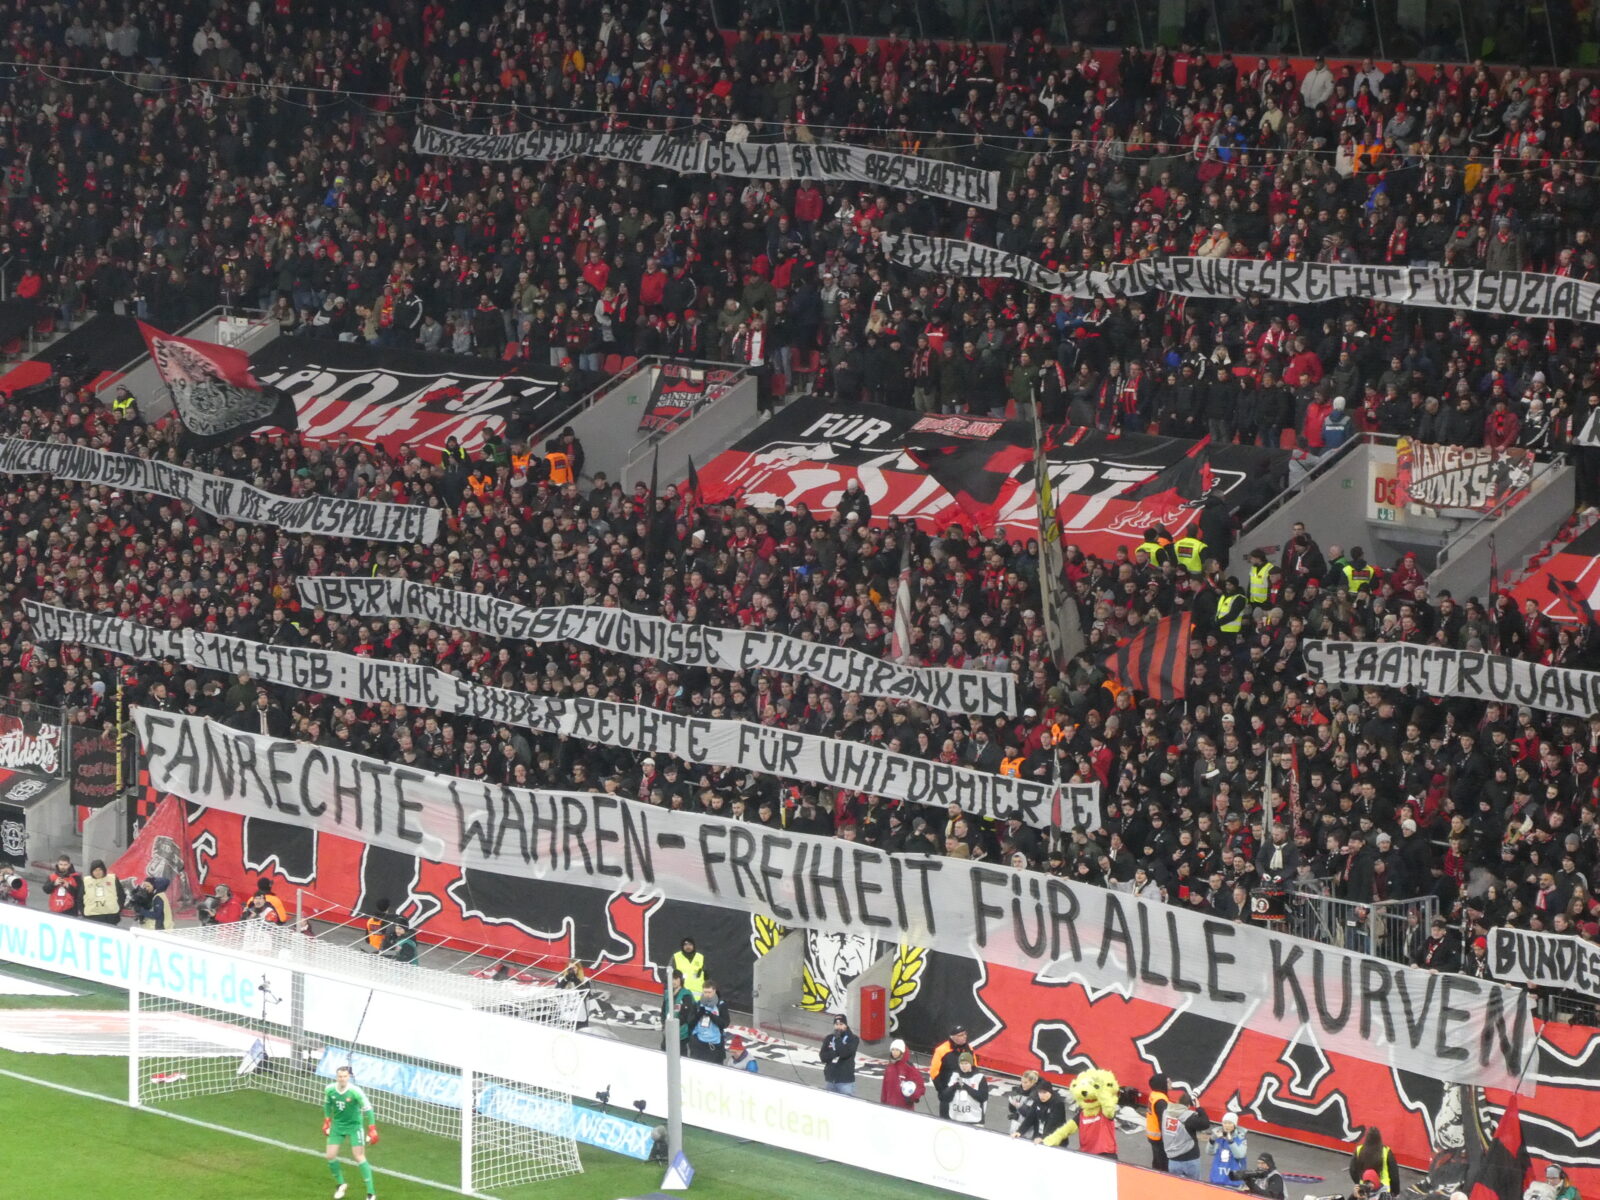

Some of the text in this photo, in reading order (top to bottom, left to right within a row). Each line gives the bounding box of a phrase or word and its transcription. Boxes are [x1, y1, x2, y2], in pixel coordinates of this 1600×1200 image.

[703, 140, 780, 177] GEWA
[791, 144, 852, 177] SPORT
[864, 154, 991, 205] ABSCHAFFEN
[1408, 267, 1474, 306] FÜR
[800, 412, 892, 444] FÜR
[202, 479, 231, 513] FÜR
[237, 486, 265, 519] DIE
[268, 497, 428, 541] BUNDESPOLIZEI
[25, 602, 124, 645] REFORM
[131, 624, 184, 661] DES
[359, 661, 440, 706] KEINE
[738, 724, 803, 775] FÜR
[739, 632, 1008, 713] EINSCHRÄNKEN
[95, 900, 106, 908] TV
[145, 715, 425, 843] FANRECHTE
[699, 824, 943, 935] FREIHEIT
[970, 866, 1082, 962] FÜR
[1096, 893, 1246, 1003] ALLE
[1269, 938, 1528, 1078] KURVEN
[576, 1113, 652, 1155] NIEDAX
[764, 1094, 832, 1141] clean
[1218, 1166, 1231, 1177] TV
